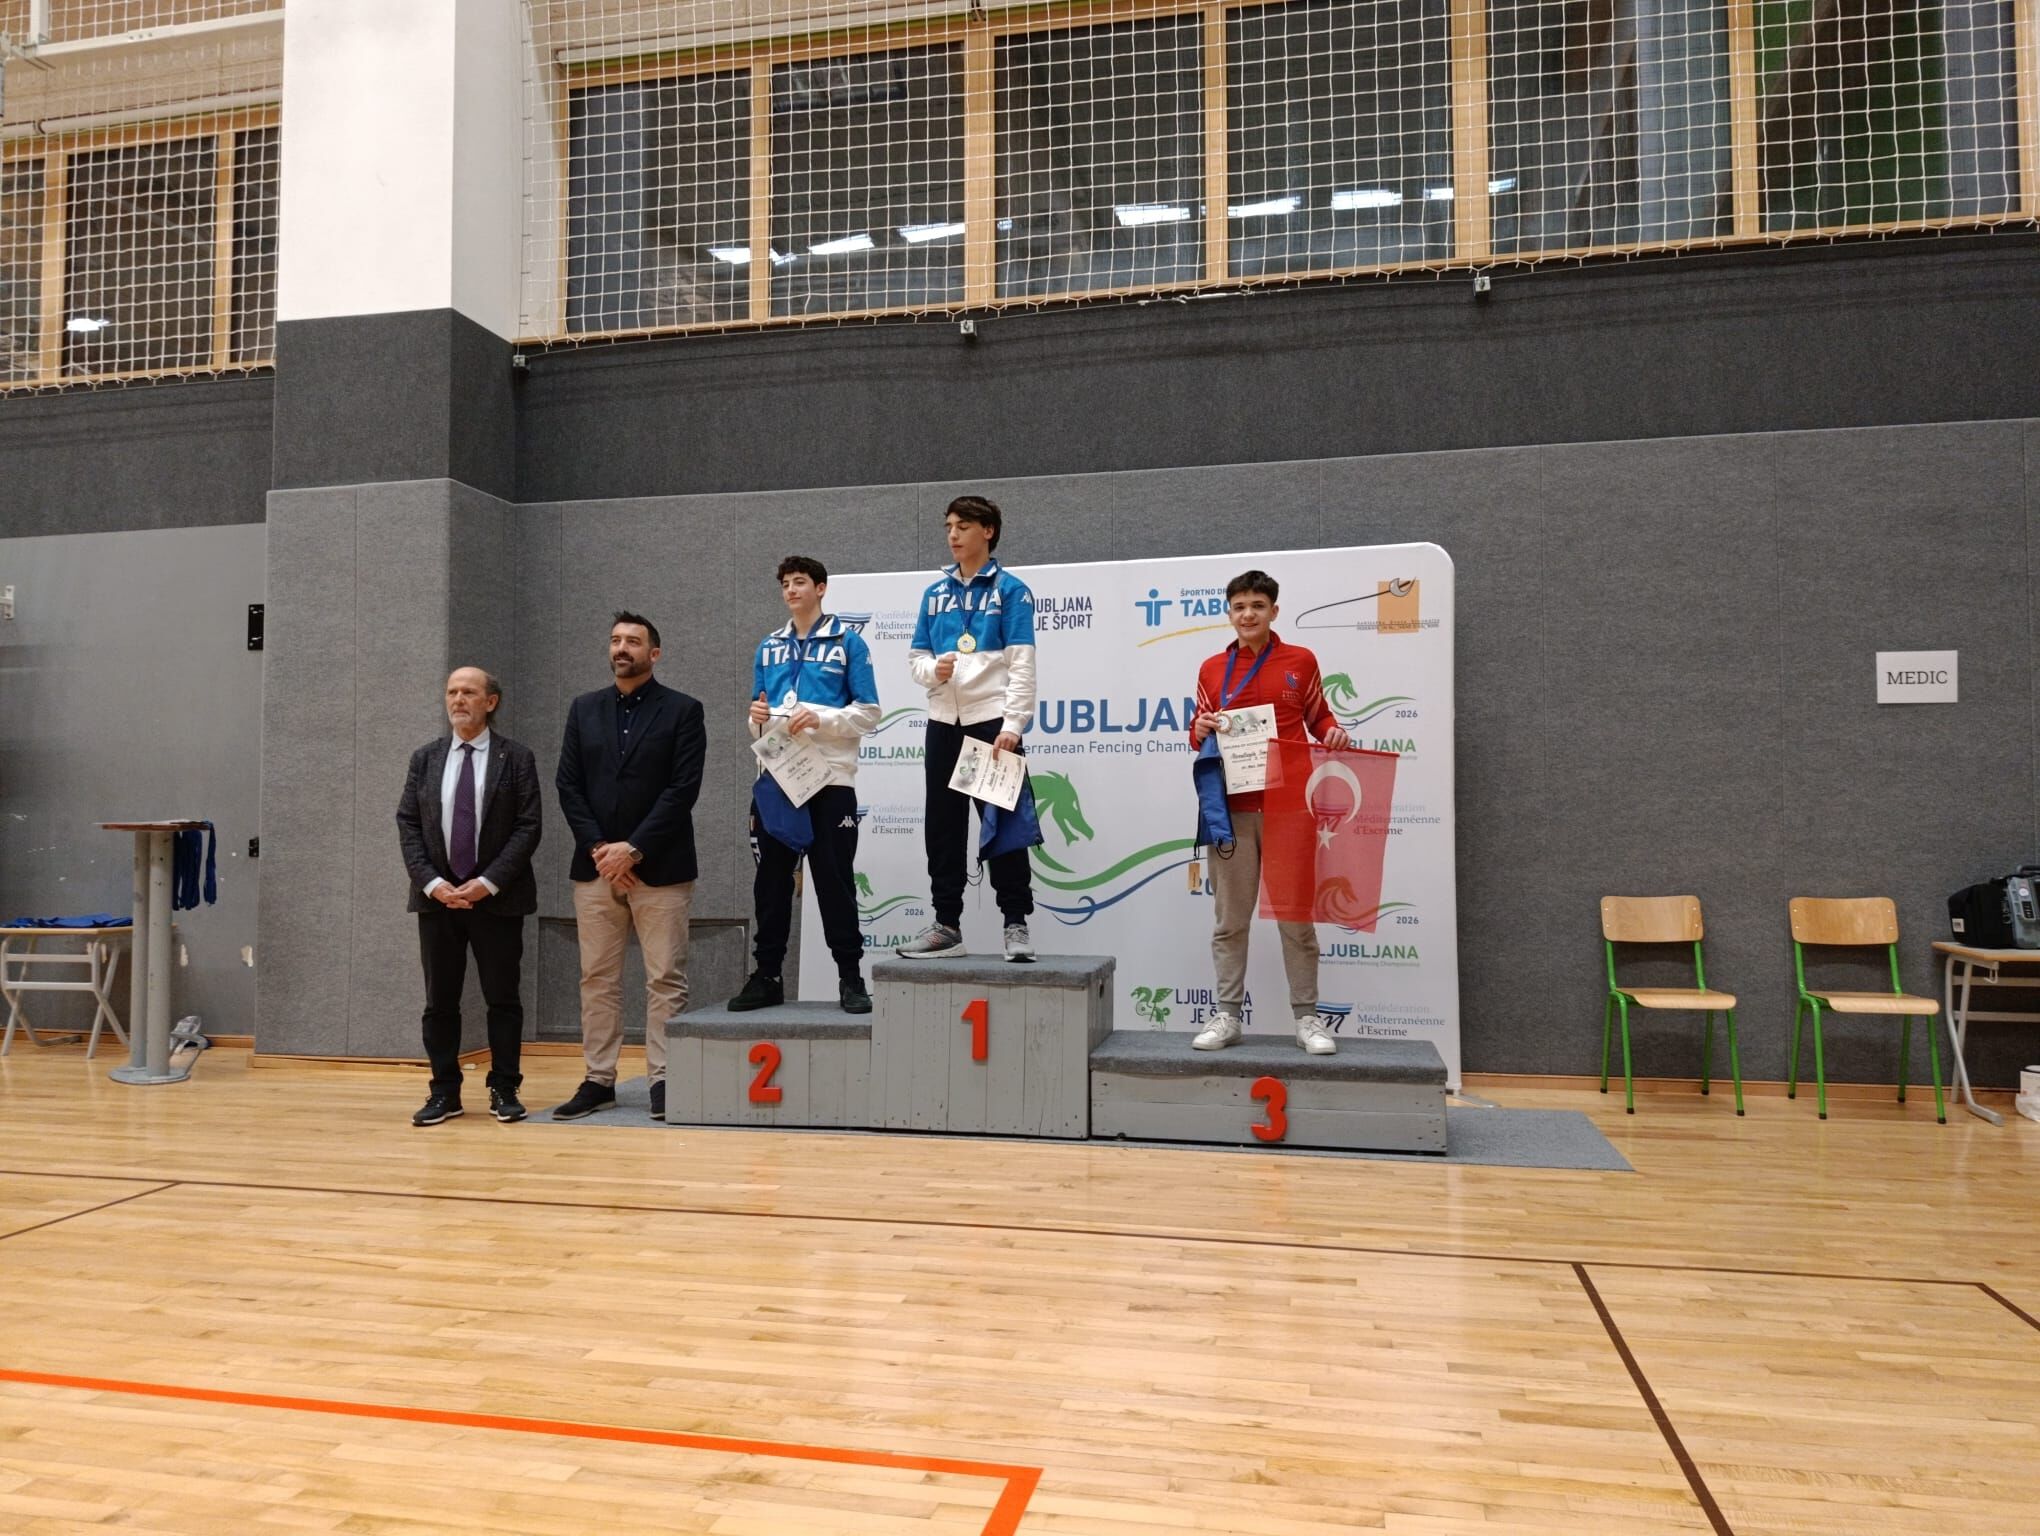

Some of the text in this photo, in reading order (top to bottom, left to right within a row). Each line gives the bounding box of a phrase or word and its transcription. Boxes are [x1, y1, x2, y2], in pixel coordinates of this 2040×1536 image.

[927, 588, 1002, 616] ITALIA
[1036, 596, 1093, 613] UBLJANA
[875, 621, 917, 631] Méditerra
[1035, 612, 1093, 631] JE ŠPORT
[874, 631, 914, 641] d'Escrim
[1886, 670, 1948, 685] MEDIC
[1395, 710, 1418, 718] 2026
[908, 720, 928, 728] 2026
[858, 747, 926, 759] UBLJANA
[1023, 743, 1085, 754] erranean
[1089, 740, 1142, 756] Fencing
[872, 825, 914, 834] d'Escrime
[905, 908, 924, 916] 2026
[1396, 916, 1420, 925] 2026
[1175, 988, 1253, 1007] LJUBLA
[1190, 1008, 1205, 1024] JE
[1357, 1013, 1445, 1026] Méditerranéenne
[960, 998, 989, 1061] 1
[1357, 1024, 1408, 1036] d'Escrime
[748, 1042, 783, 1102] 2
[1250, 1076, 1288, 1142] 3
